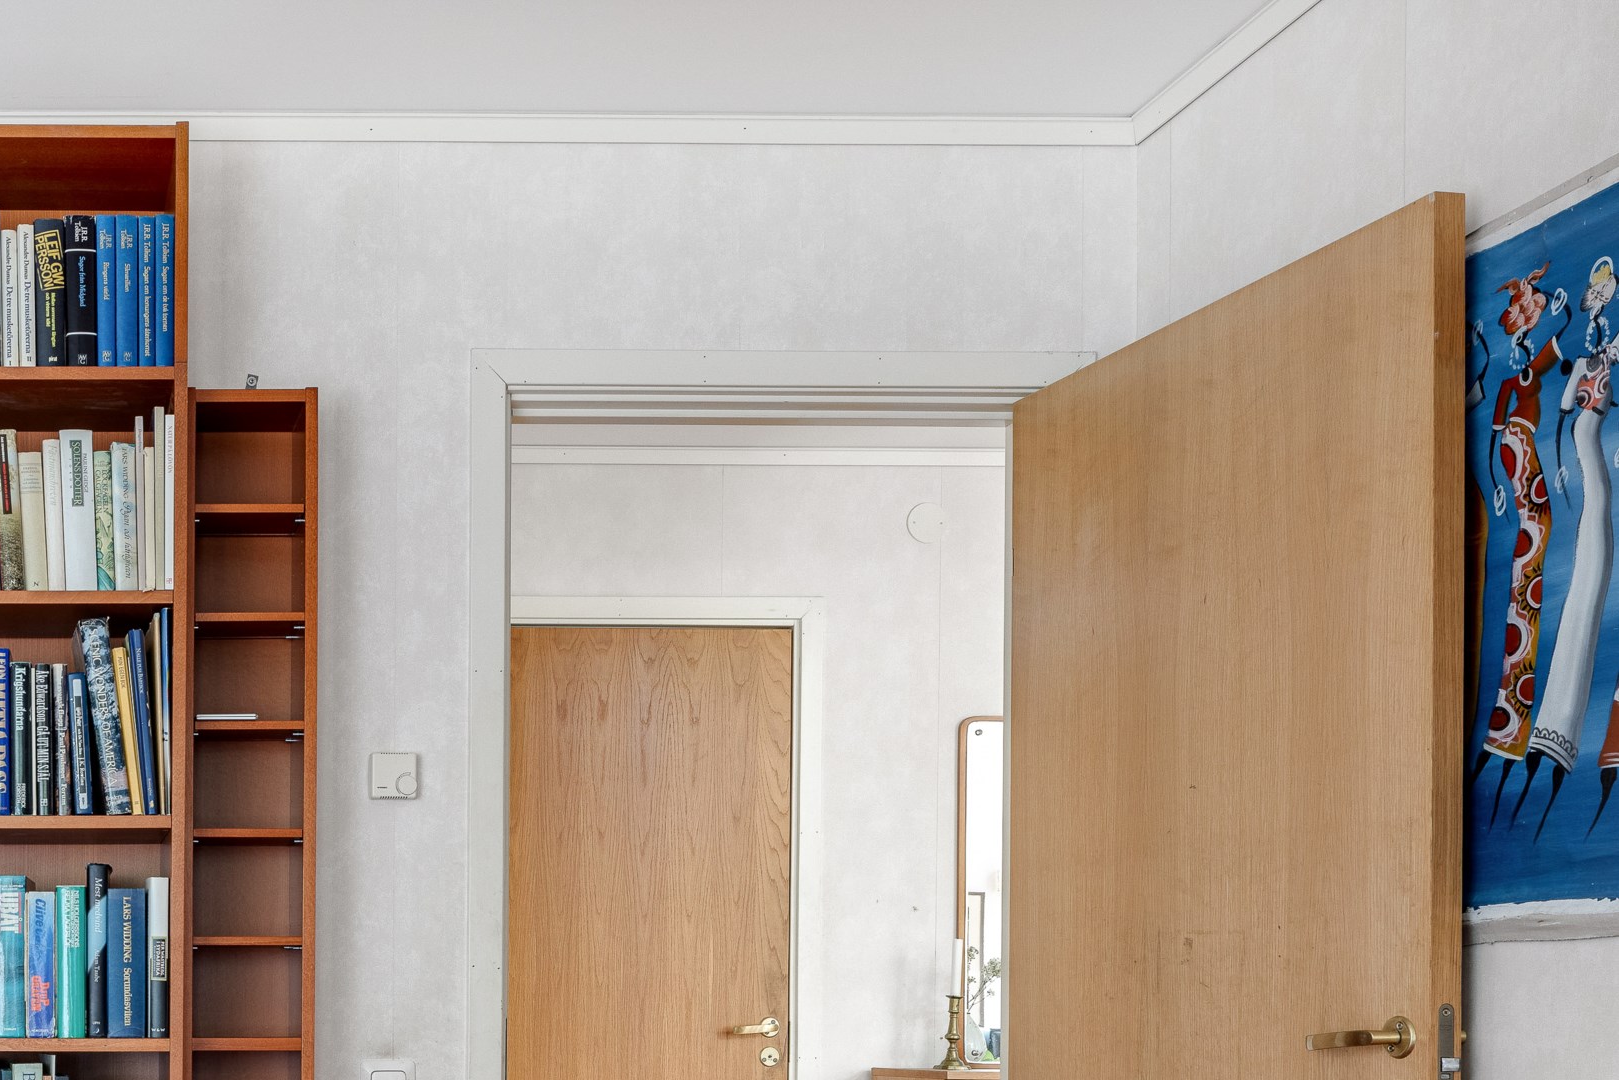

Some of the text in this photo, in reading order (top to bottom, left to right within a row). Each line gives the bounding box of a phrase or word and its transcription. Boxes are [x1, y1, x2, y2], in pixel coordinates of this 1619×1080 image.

[22, 231, 30, 260] Alexandre
[35, 236, 55, 289] PERSSON
[45, 232, 64, 285] LEIF GW
[23, 281, 31, 292] De
[23, 303, 33, 354] musketörerna
[70, 441, 83, 506] SOLENS DOTTER
[13, 666, 26, 731] Krigshundarna
[89, 627, 118, 785] SCENIC WONDERS OF AMERICA
[35, 670, 50, 783] Åke Edwardson GÅ UT MIN SJÄL
[0, 892, 23, 934] UBÅT
[122, 896, 133, 1026] LARS WIDDING Sorundasviten
